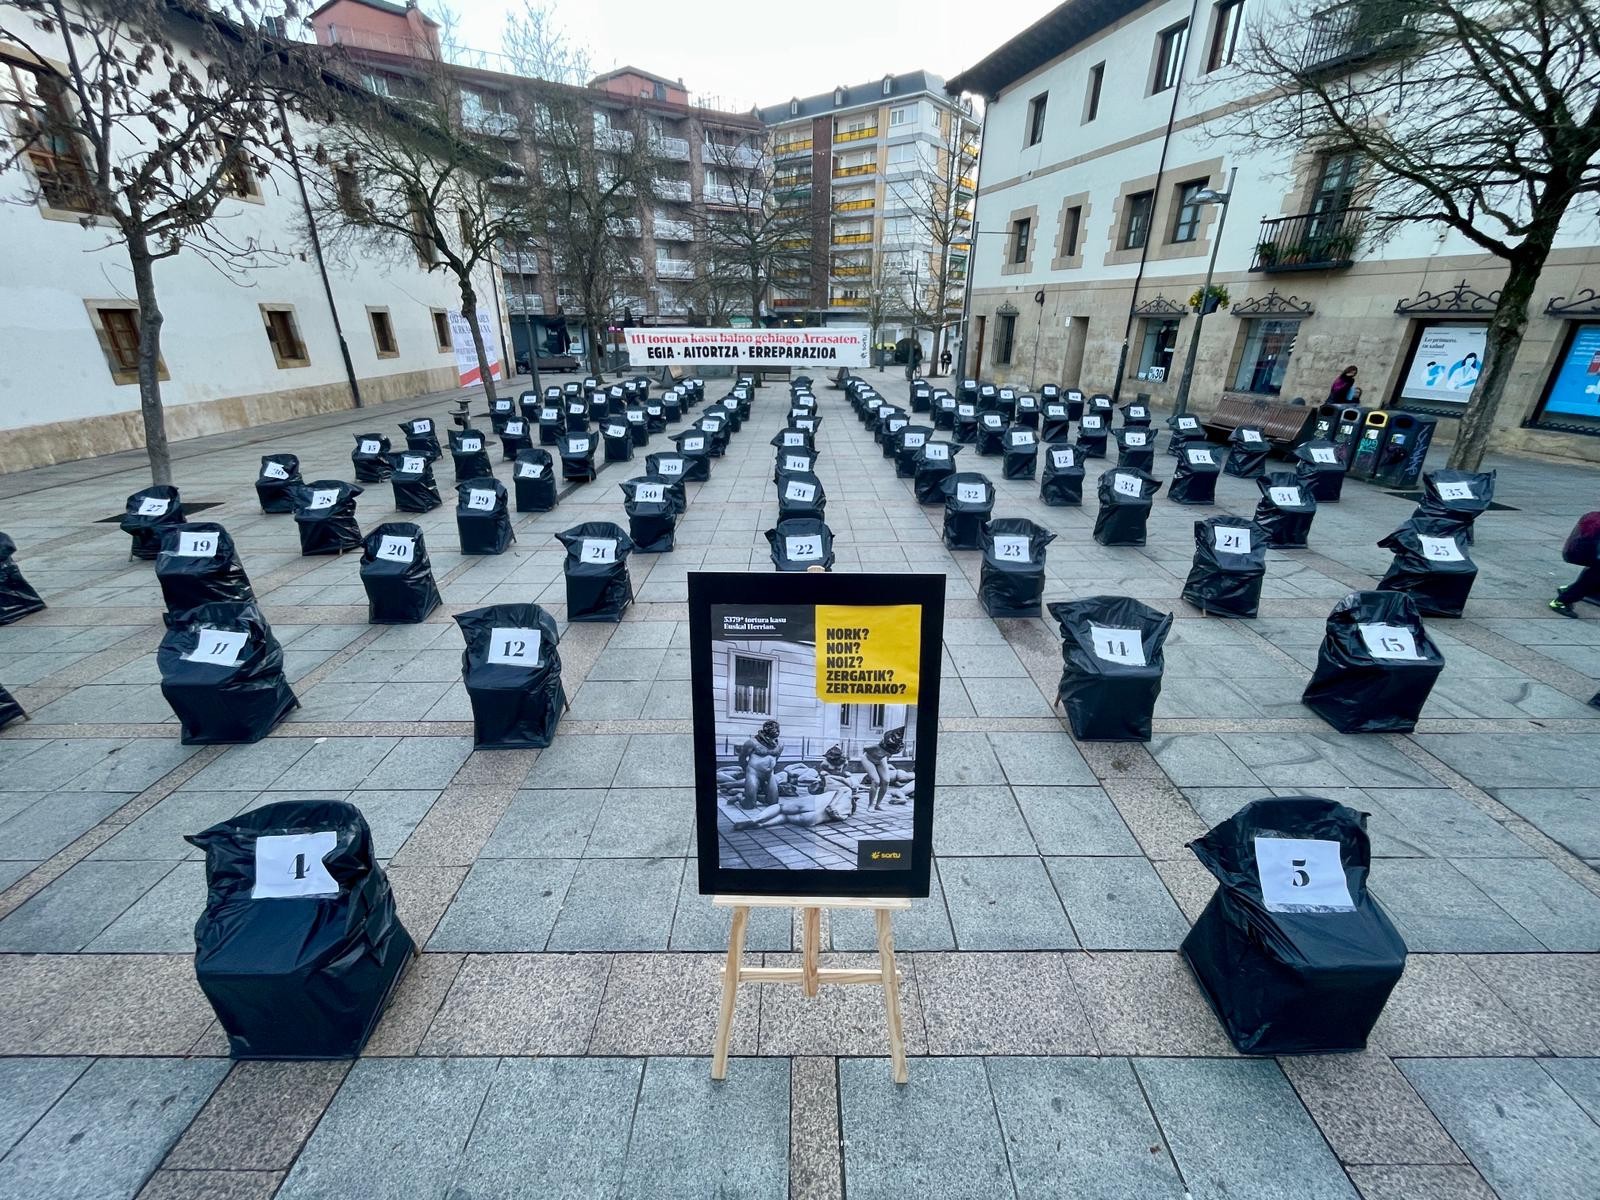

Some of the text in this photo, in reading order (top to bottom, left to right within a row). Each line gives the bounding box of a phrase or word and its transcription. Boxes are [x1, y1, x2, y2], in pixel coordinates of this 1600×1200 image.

[648, 334, 689, 344] tortura
[690, 333, 718, 344] kasu
[719, 332, 753, 344] baino
[754, 333, 800, 346] gehiago
[801, 333, 861, 345] Arrasaten.
[647, 345, 837, 360] EGIA AITORTZA ERREPARAZIOA
[408, 462, 420, 470] 37
[1121, 480, 1134, 492] 33
[1446, 487, 1463, 497] 35
[320, 496, 332, 504] 28
[475, 495, 489, 505] 29
[641, 490, 657, 499] 30
[964, 490, 979, 499] 32
[146, 504, 163, 512] 27
[192, 539, 210, 552] 19
[388, 544, 407, 556] 20
[795, 543, 813, 555] 22
[1003, 544, 1021, 557] 23
[1432, 544, 1450, 556] 25
[826, 628, 870, 641] NORK?
[209, 642, 229, 655] 11
[502, 640, 526, 657] 12
[826, 642, 861, 654] NON?
[1105, 640, 1130, 657] 14
[1380, 637, 1406, 652] 15
[826, 656, 864, 669] NOIZ?
[826, 669, 894, 682] ZERGATIK?
[826, 682, 907, 695] ZERTARAKO?
[287, 853, 312, 880] 4
[1291, 859, 1310, 887] 5
